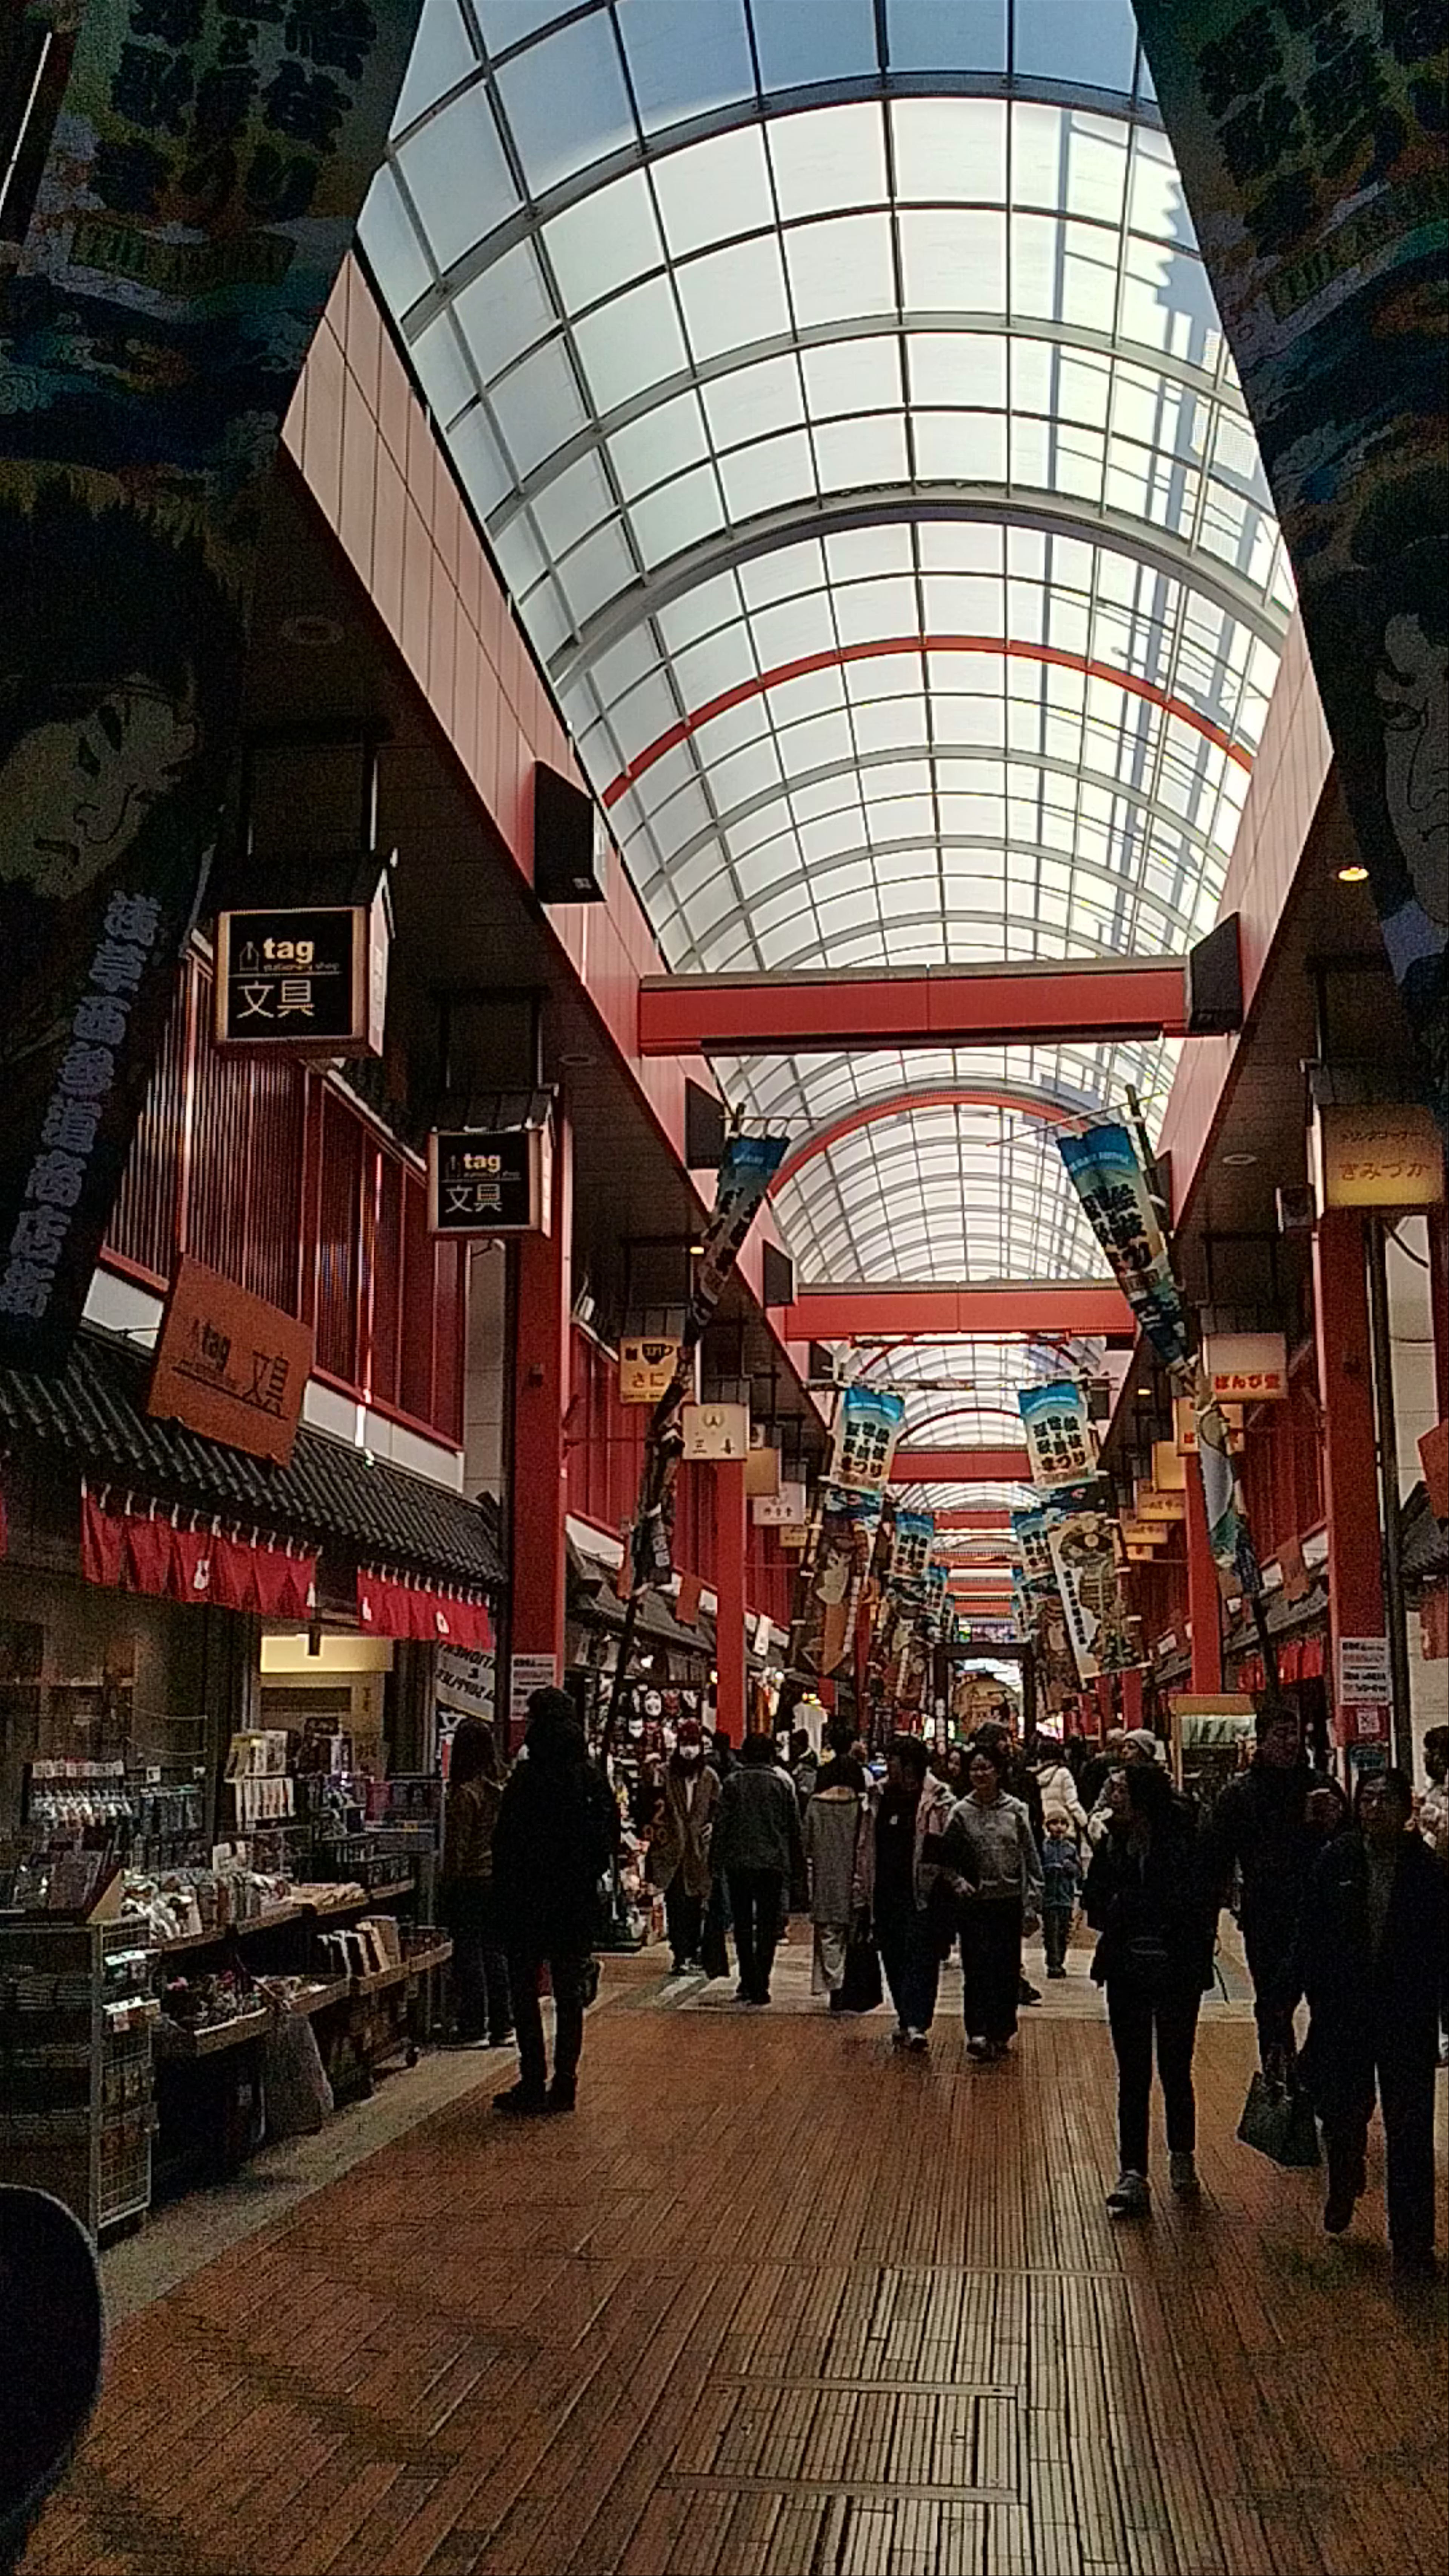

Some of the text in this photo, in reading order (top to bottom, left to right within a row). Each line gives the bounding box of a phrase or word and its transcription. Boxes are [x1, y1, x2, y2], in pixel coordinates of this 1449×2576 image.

[263, 937, 315, 964] tag
[237, 980, 315, 1019] 文具
[463, 1153, 501, 1173] tag
[445, 1184, 503, 1213] 文具
[1041, 1450, 1086, 1471] まつり
